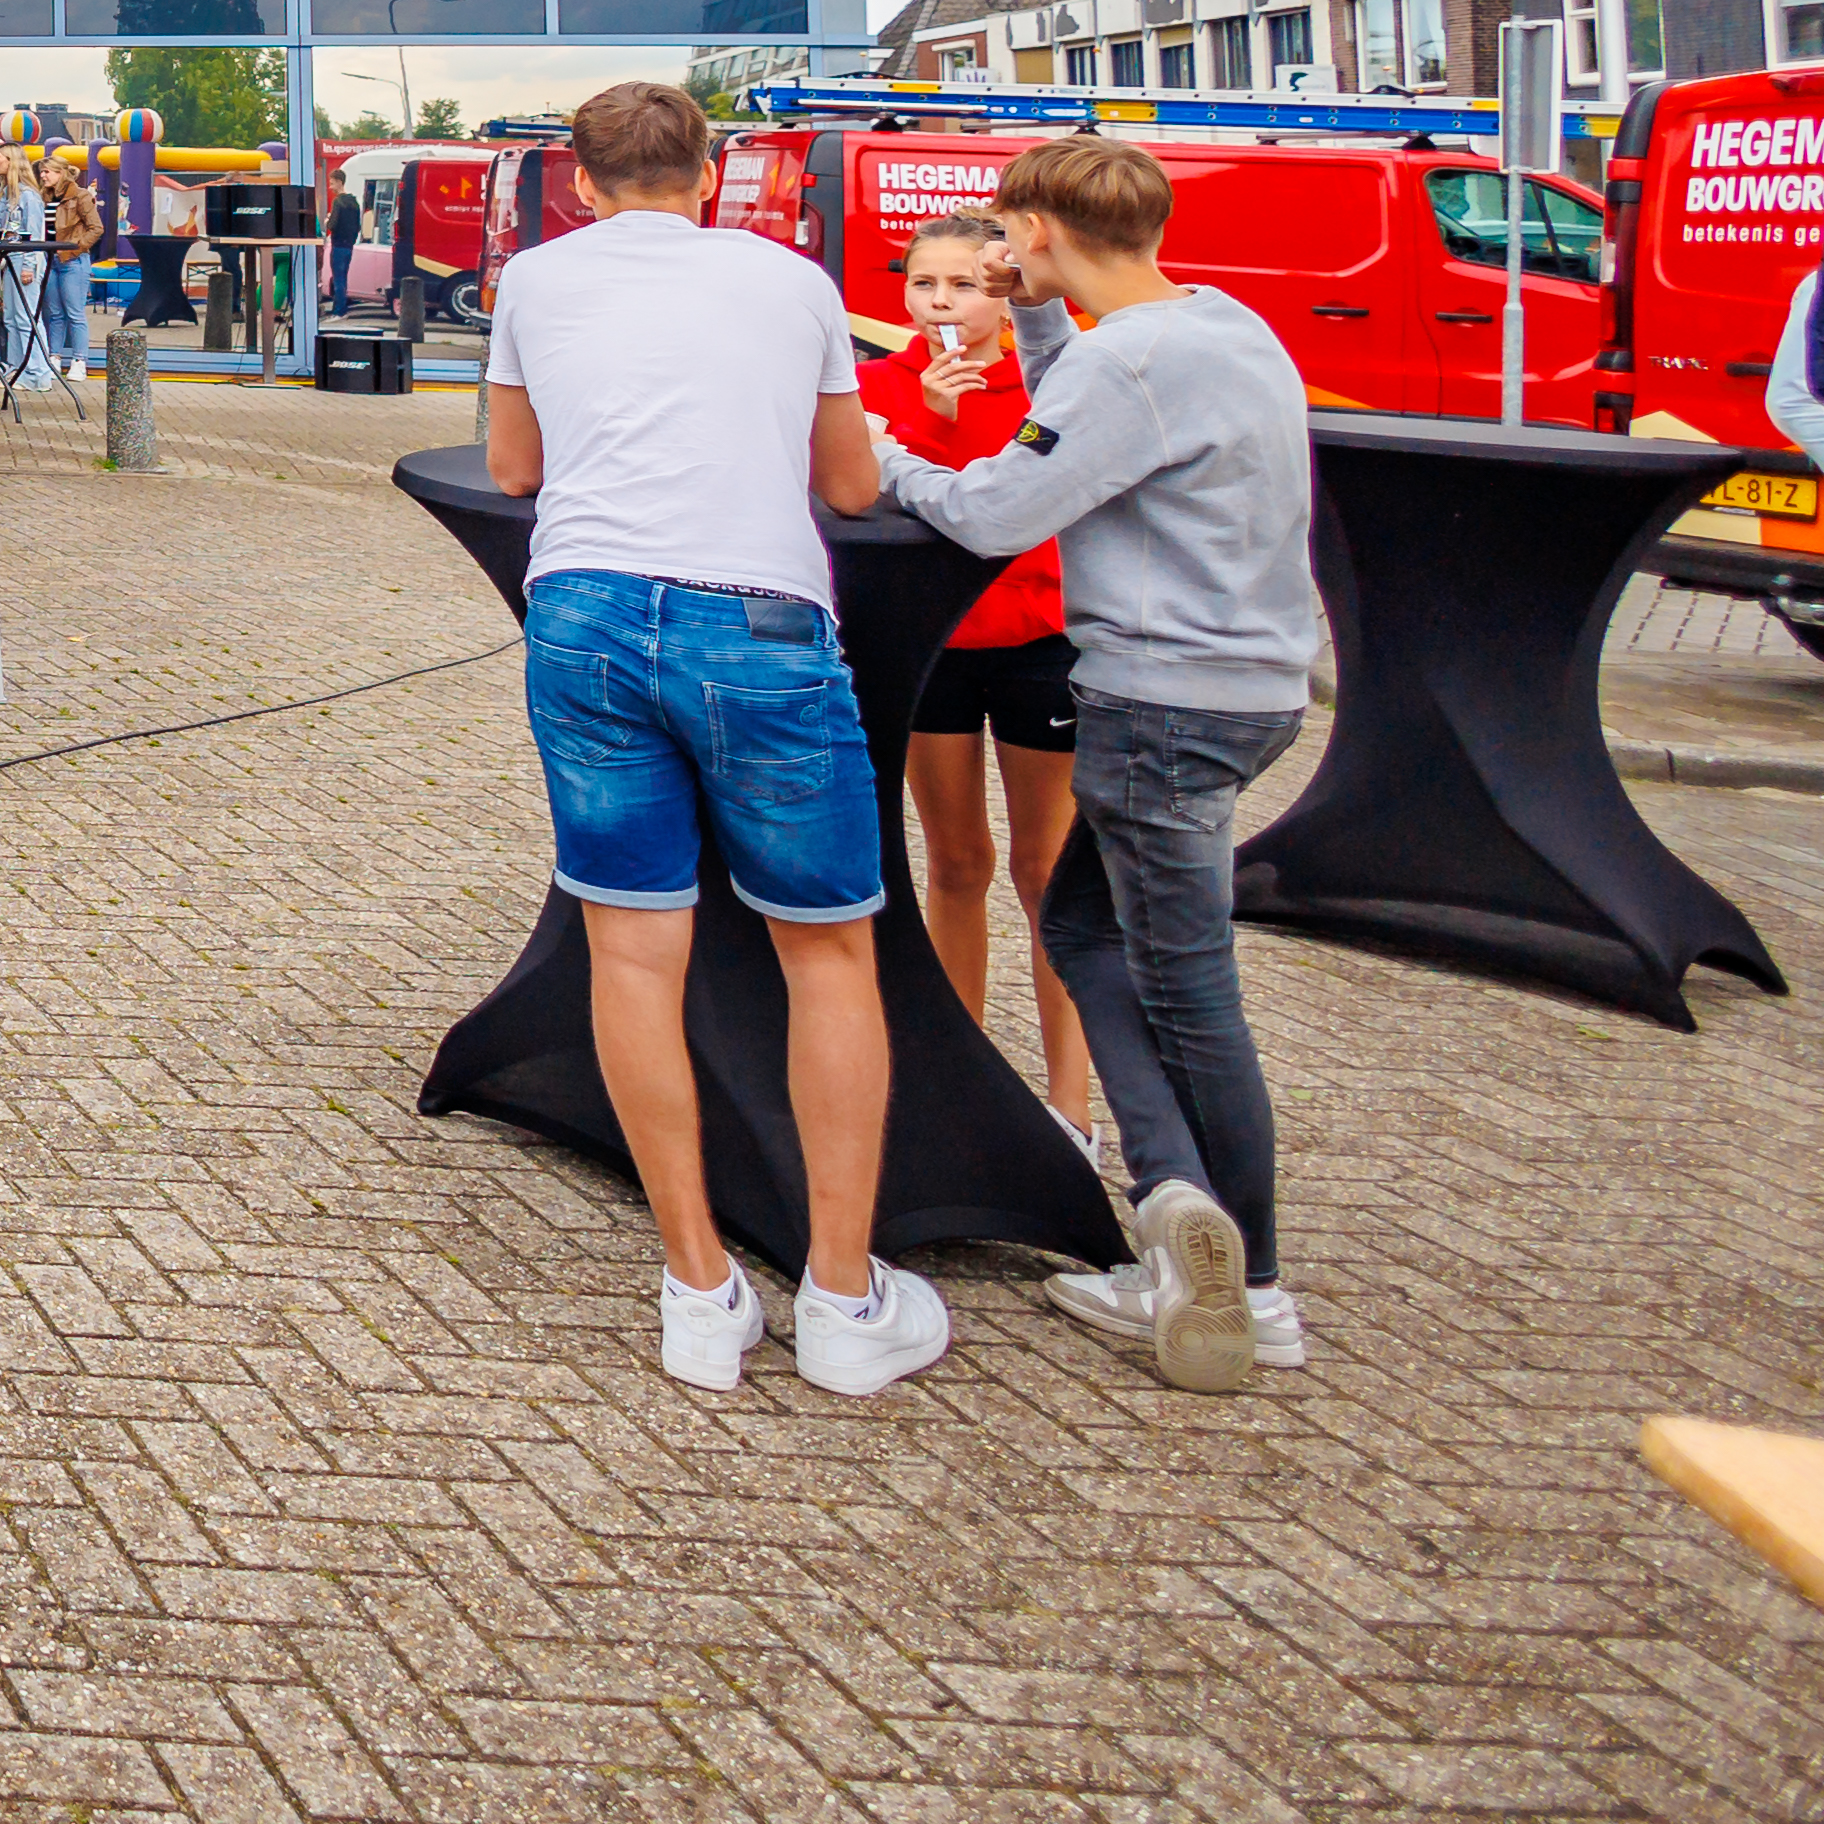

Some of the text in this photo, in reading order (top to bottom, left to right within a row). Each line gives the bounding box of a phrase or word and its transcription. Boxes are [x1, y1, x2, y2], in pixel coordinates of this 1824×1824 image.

[1690, 118, 1824, 168] HEGEM
[878, 162, 1000, 192] HEGEMA
[1685, 174, 1824, 212] BOUWGR
[232, 207, 272, 215] BOSE
[1682, 223, 1821, 246] betekenis ge
[328, 360, 370, 370] BOSE
